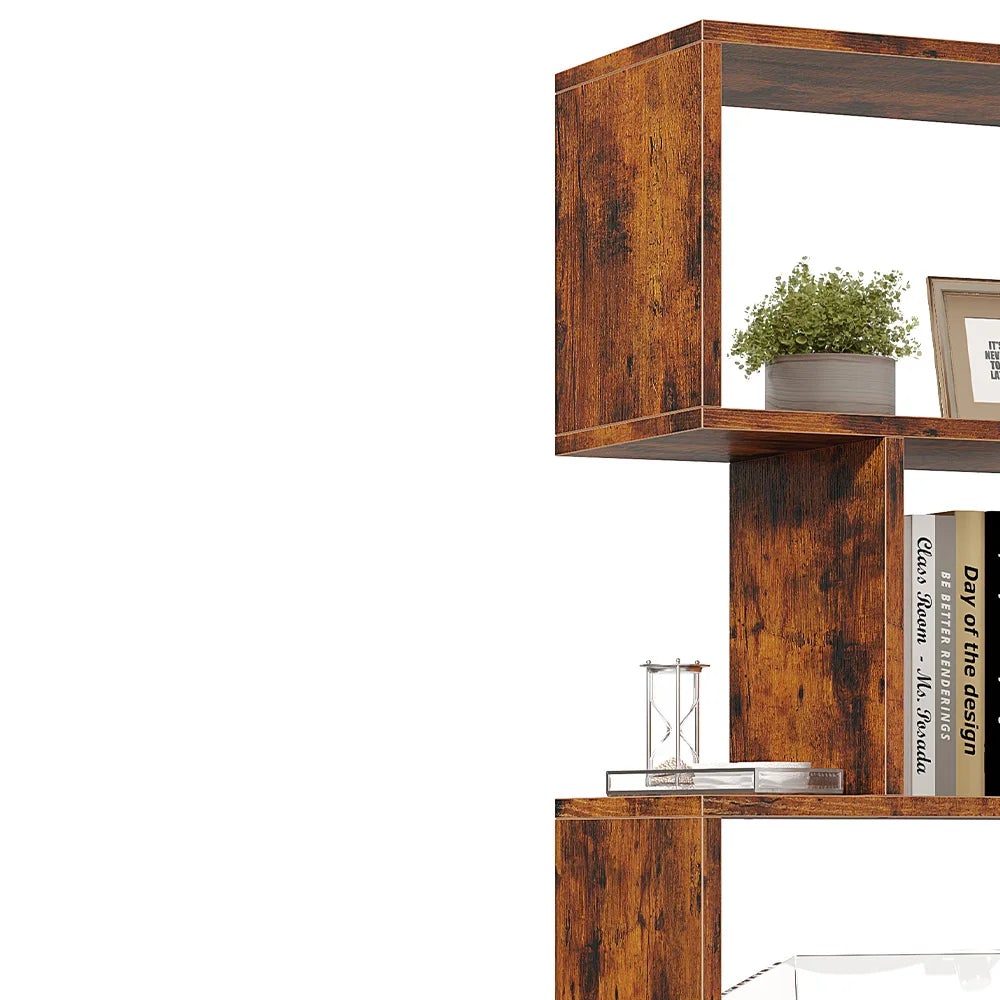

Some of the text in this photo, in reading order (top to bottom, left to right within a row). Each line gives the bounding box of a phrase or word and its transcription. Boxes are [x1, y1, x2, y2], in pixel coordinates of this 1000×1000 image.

[917, 536, 932, 585] Class
[917, 593, 932, 645] Room
[917, 668, 932, 703] Ms.
[941, 571, 950, 741] BE BETTER RENDERINGS
[960, 565, 979, 755] Day of the design
[917, 707, 932, 775] Posada
